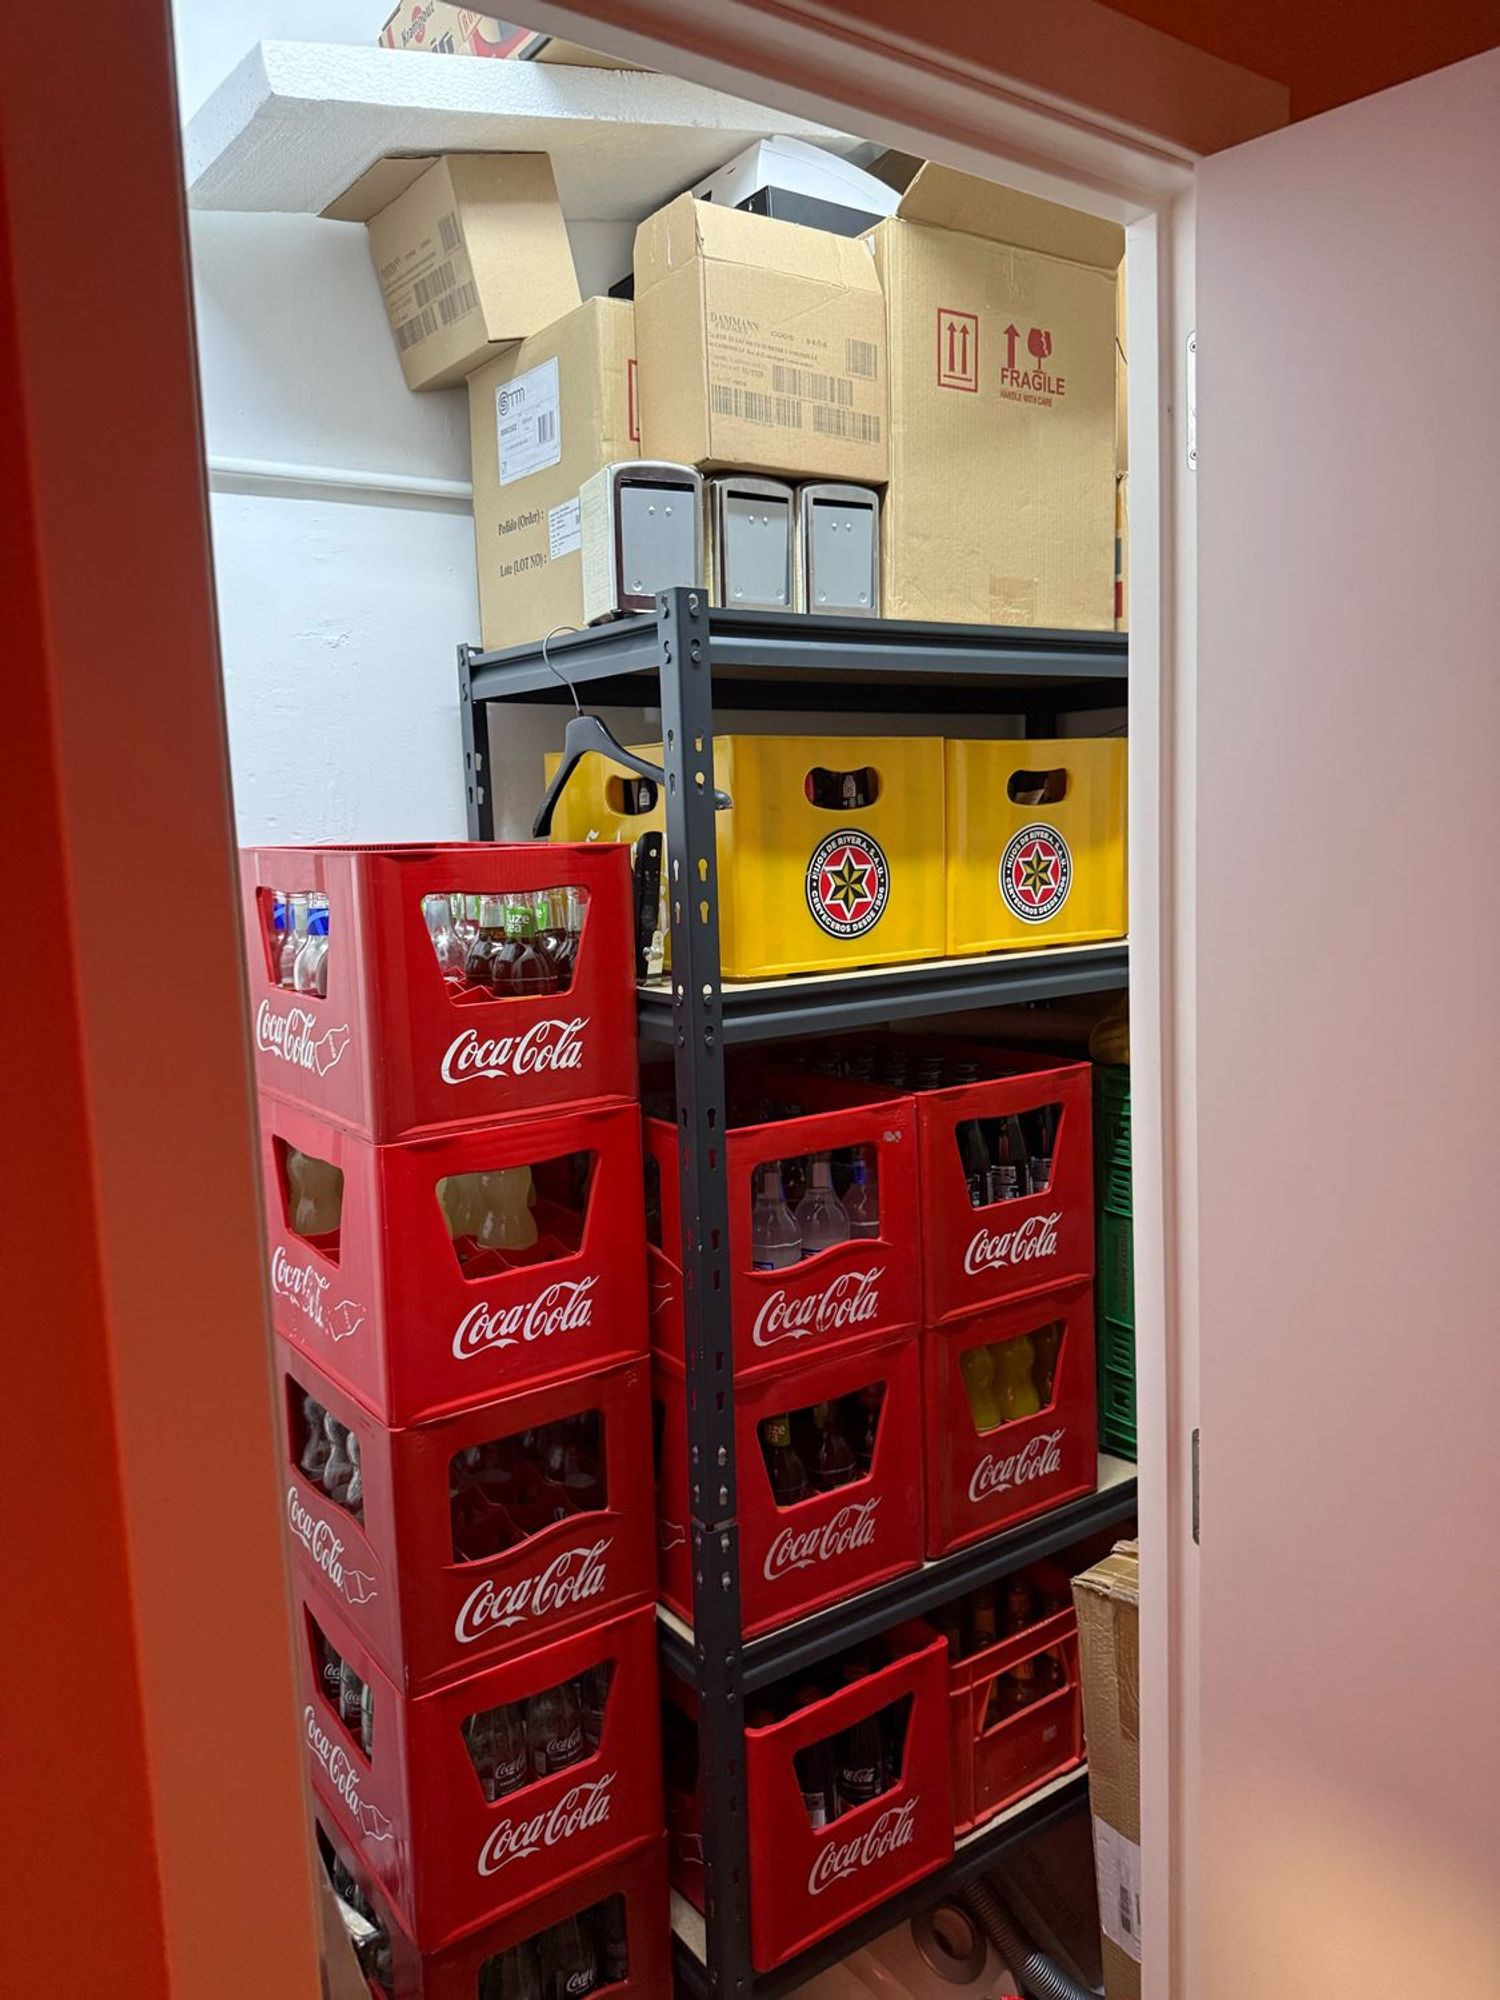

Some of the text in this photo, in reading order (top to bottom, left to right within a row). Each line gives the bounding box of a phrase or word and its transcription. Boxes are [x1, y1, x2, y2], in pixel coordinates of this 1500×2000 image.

[1000, 389, 1022, 402] HANDLE
[1001, 367, 1066, 396] FRAGILE
[812, 851, 828, 880] HIJOS
[826, 841, 837, 853] DE
[1020, 835, 1030, 844] DE
[812, 890, 851, 933] CERVECEROS
[852, 910, 877, 932] DESDE
[1006, 878, 1038, 915] CERVECEROS
[1039, 897, 1058, 914] DESDE
[256, 1000, 316, 1069] Coca-Cola
[441, 1018, 590, 1085] Coca-Cola
[965, 1213, 1063, 1275] Coca-Cola
[453, 1276, 600, 1360] Coca-Cola
[753, 1268, 885, 1347] Coca-Cola
[969, 1429, 1066, 1503] Coca-Cola
[287, 1487, 345, 1588] Coca-Cola
[764, 1498, 882, 1581] Coca-Cola
[455, 1538, 613, 1644] Coca-Cola
[304, 1704, 361, 1815] Coca-Cola
[478, 1772, 617, 1877] Coca-Cola
[808, 1795, 920, 1896] Coca-Cola
